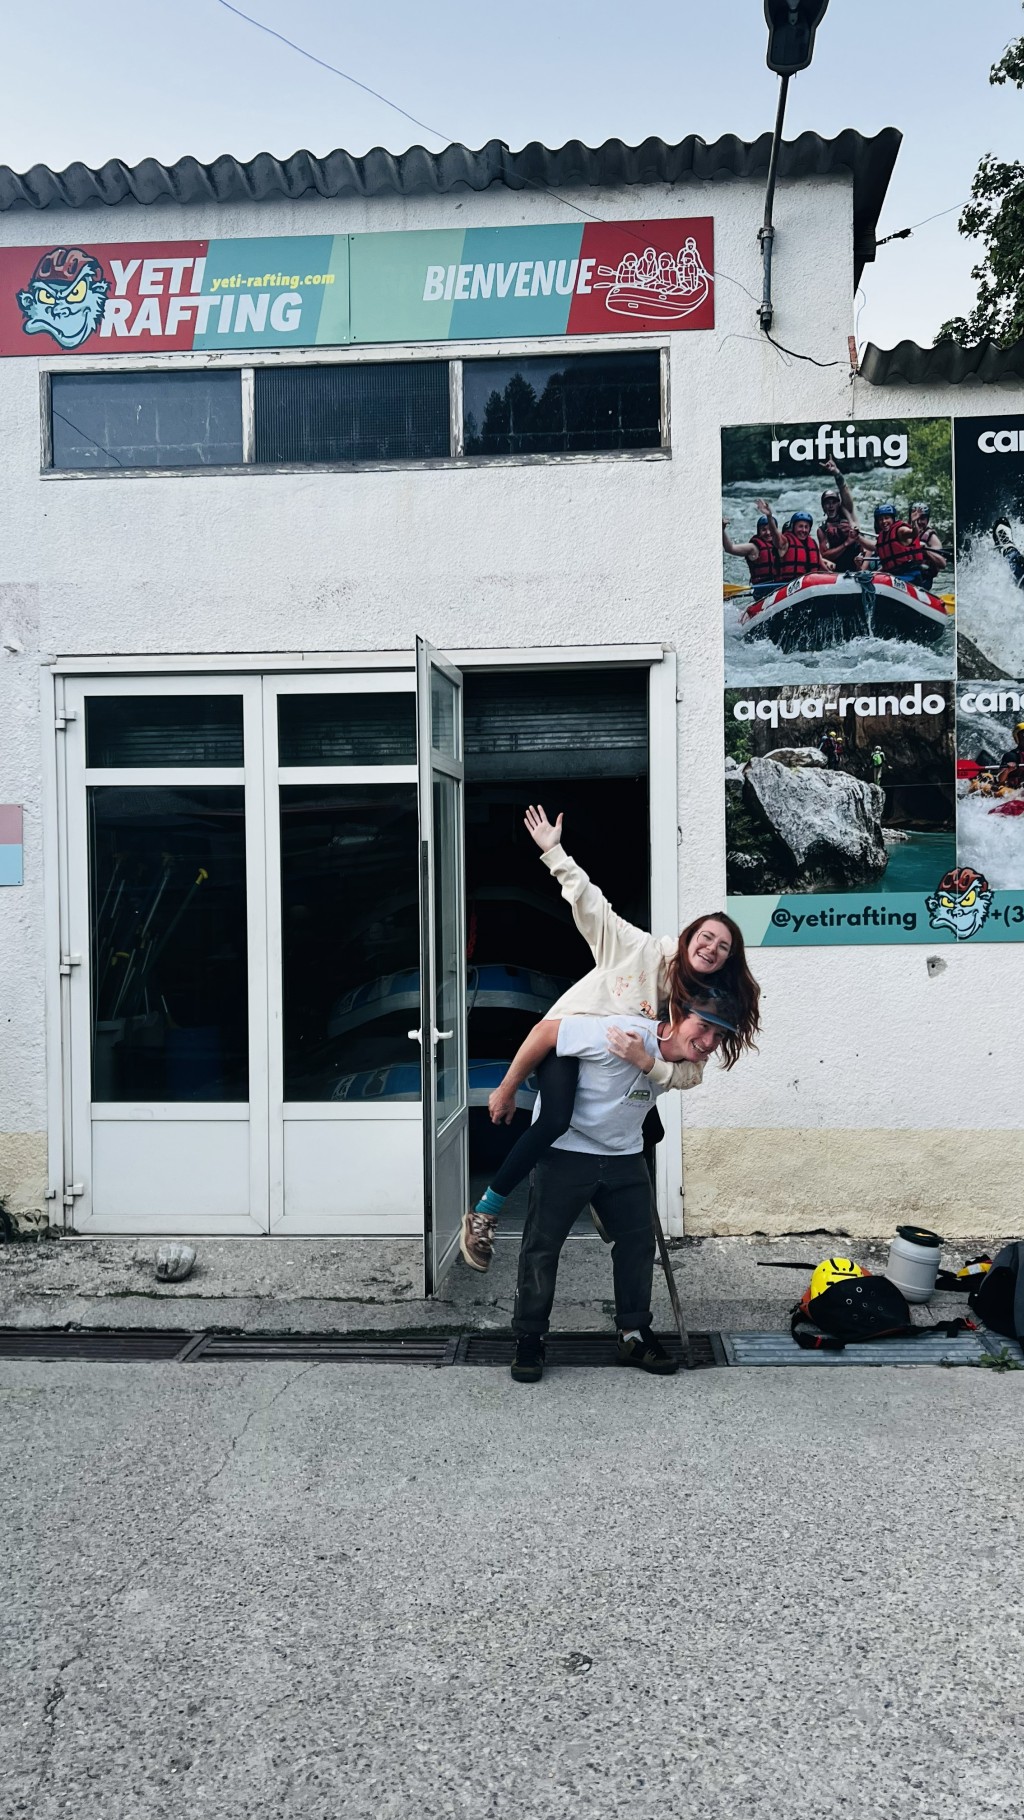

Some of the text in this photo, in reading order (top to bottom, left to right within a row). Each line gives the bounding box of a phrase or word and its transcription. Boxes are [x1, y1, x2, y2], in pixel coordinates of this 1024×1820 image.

[109, 256, 207, 296] YETI
[210, 272, 335, 292] yeti-rafting.com
[422, 258, 597, 301] BIENVENUE
[100, 292, 303, 338] RAFTING
[771, 424, 908, 467] rafting
[978, 430, 1024, 453] ca
[733, 684, 946, 729] aqua-rando
[960, 691, 1024, 713] can
[771, 905, 917, 932] @yetirafting
